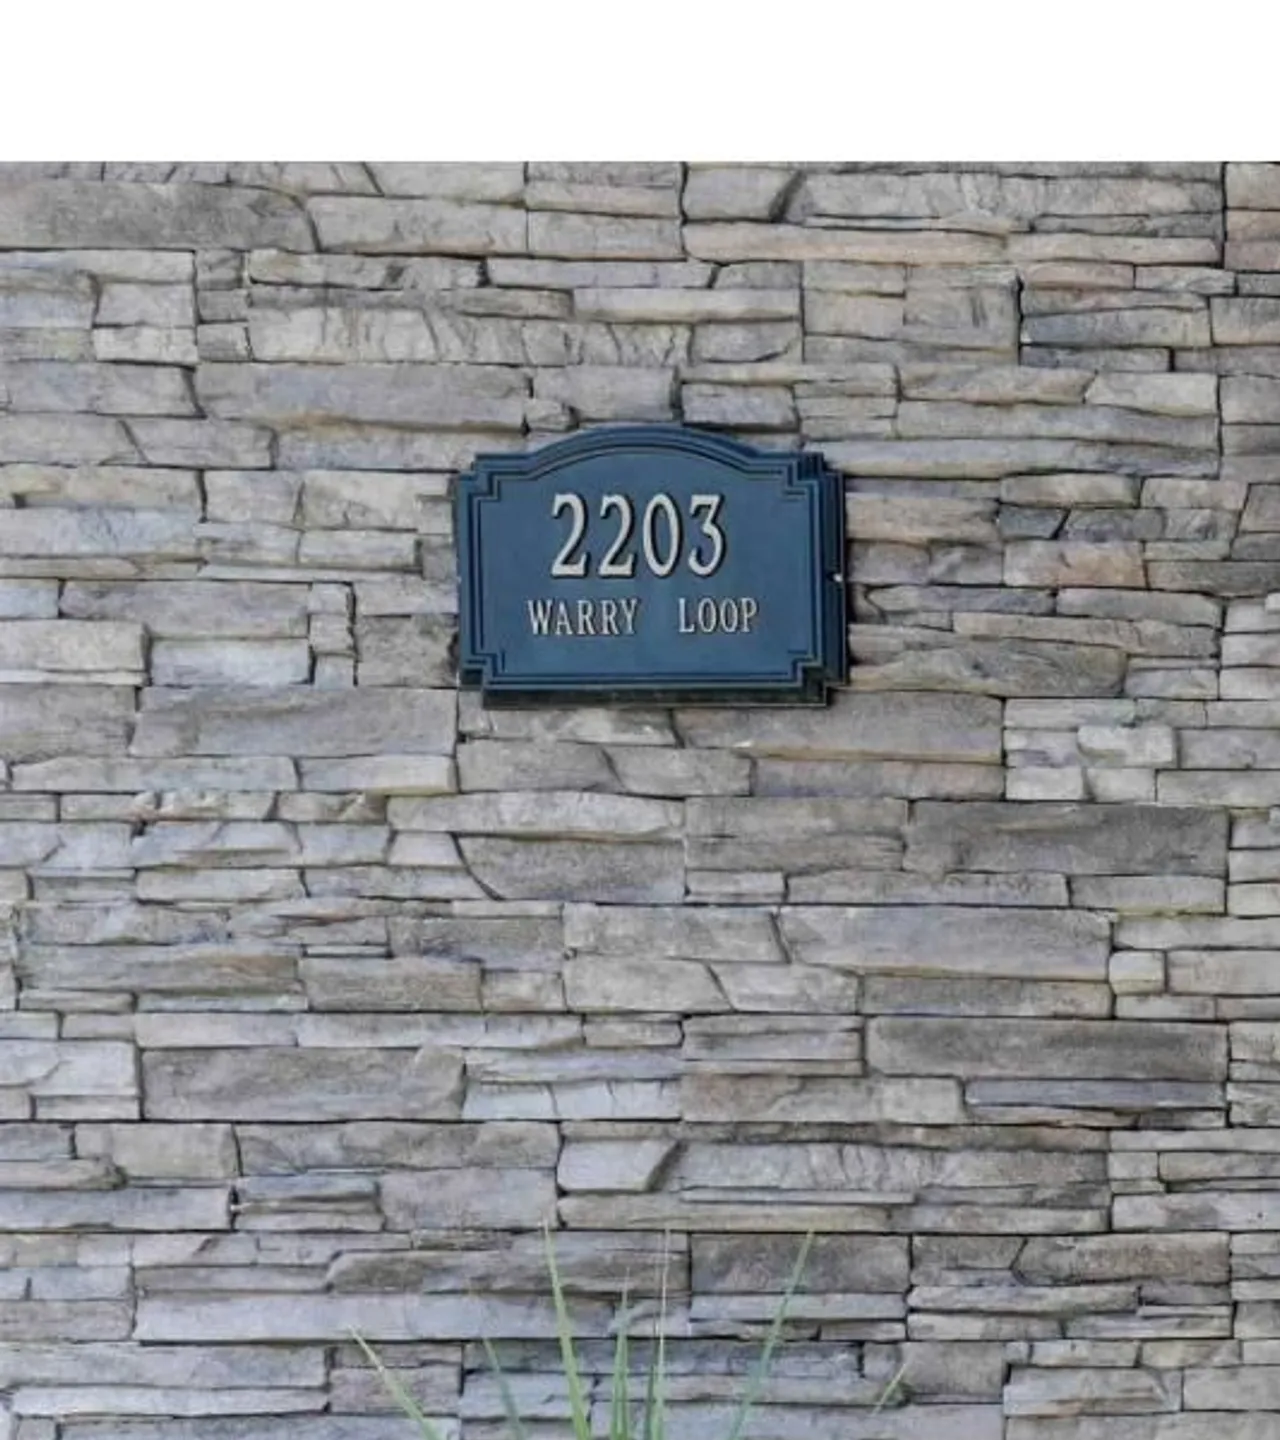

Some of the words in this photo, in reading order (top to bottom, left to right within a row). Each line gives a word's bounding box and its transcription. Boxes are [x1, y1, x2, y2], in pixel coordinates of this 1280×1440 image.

[551, 493, 726, 577] 2203
[527, 598, 639, 635] WARRY
[678, 597, 759, 634] LOOP
